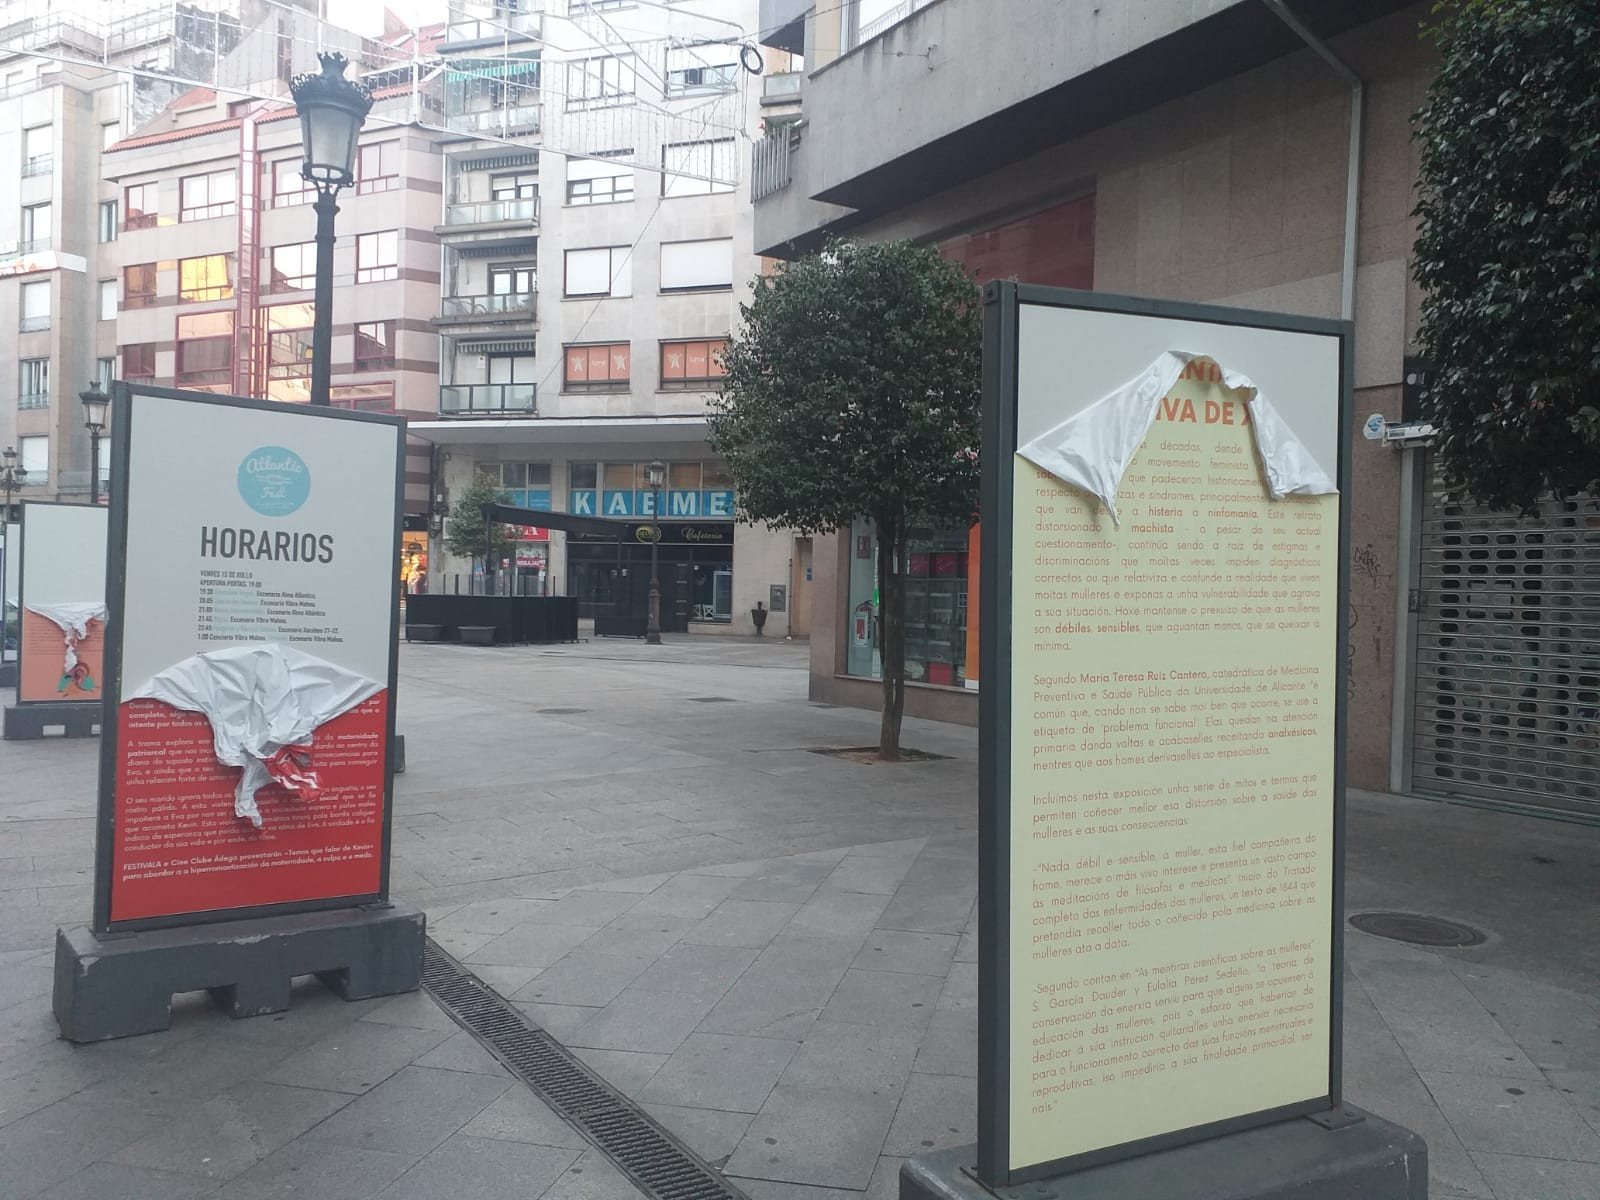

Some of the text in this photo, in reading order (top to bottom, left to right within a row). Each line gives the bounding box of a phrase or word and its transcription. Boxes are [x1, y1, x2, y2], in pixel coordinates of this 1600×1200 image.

[1204, 400, 1234, 425] DE
[1064, 506, 1082, 514] van
[1148, 505, 1183, 516] histeria
[1268, 508, 1284, 518] Este
[1293, 508, 1321, 519] retrato
[1034, 519, 1241, 537] distorsionado machista pesar
[200, 525, 334, 564] HORARIOS
[1176, 538, 1204, 549] sendo
[1271, 539, 1308, 553] estigmas
[1148, 555, 1179, 565] moitas
[1034, 571, 1081, 583] correctos
[1124, 571, 1167, 582] relativiza
[1180, 571, 1222, 582] confunde
[1235, 571, 1278, 581] realidade
[1034, 588, 1067, 600] moitas
[1071, 588, 1110, 600] mulleres
[1176, 587, 1198, 598] unha
[1290, 589, 1320, 600] agrava
[1115, 604, 1140, 616] Hoxe
[1143, 604, 1187, 615] mantense
[1287, 602, 1319, 612] mulleres
[1034, 626, 1050, 635] son
[1166, 619, 1209, 634] aguantan
